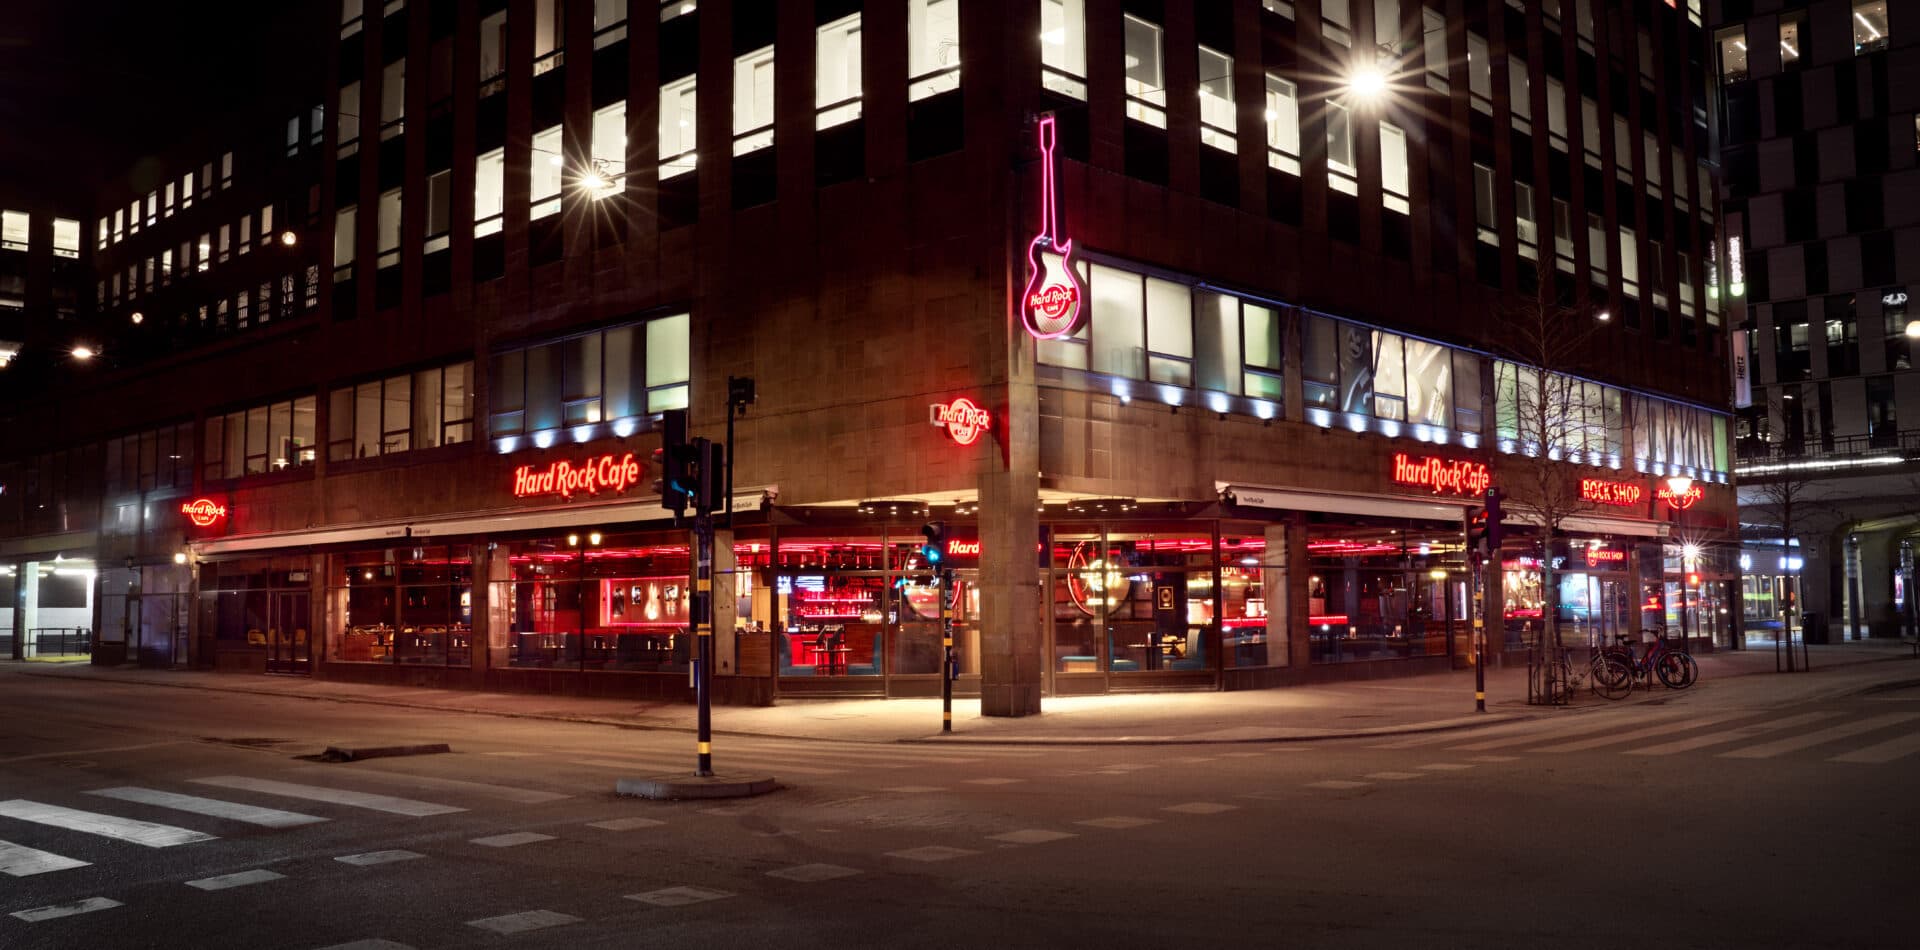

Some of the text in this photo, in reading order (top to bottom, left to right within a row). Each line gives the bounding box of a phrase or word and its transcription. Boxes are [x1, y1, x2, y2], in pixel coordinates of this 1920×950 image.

[1031, 287, 1073, 306] Hard Rock
[1736, 356, 1745, 379] Hertz
[939, 405, 990, 429] Hard Rock
[515, 452, 639, 496] Hard Rock Cafe
[1395, 453, 1490, 495] Hard Rock Cafe
[1583, 479, 1640, 504] ROCK SHOP
[182, 503, 226, 517] Hard Rock
[948, 540, 980, 554] Hard
[1599, 551, 1611, 561] ROCK
[1611, 552, 1624, 561] SHOP
